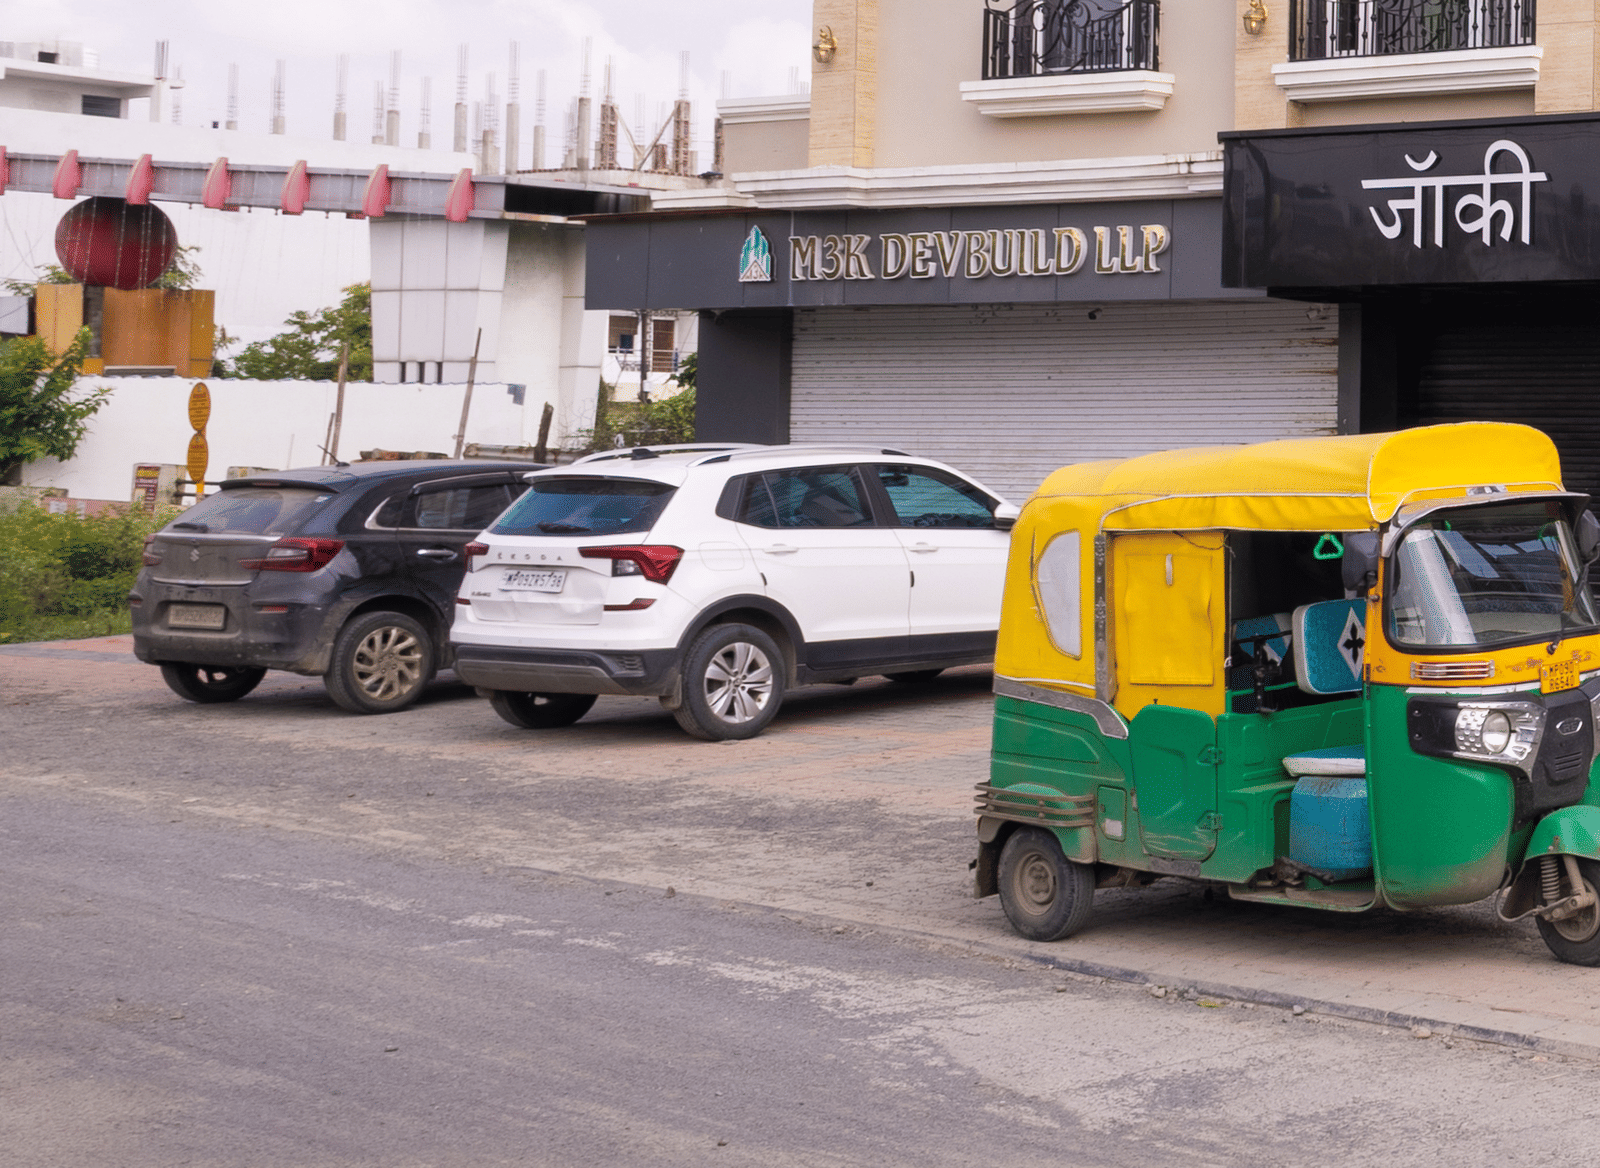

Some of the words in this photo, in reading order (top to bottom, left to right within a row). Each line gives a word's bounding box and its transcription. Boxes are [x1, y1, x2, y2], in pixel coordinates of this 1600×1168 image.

[1361, 139, 1548, 249] जॉकी
[790, 233, 875, 281] M3K
[880, 226, 1088, 280] DEVBUILD
[1094, 223, 1171, 275] LLP
